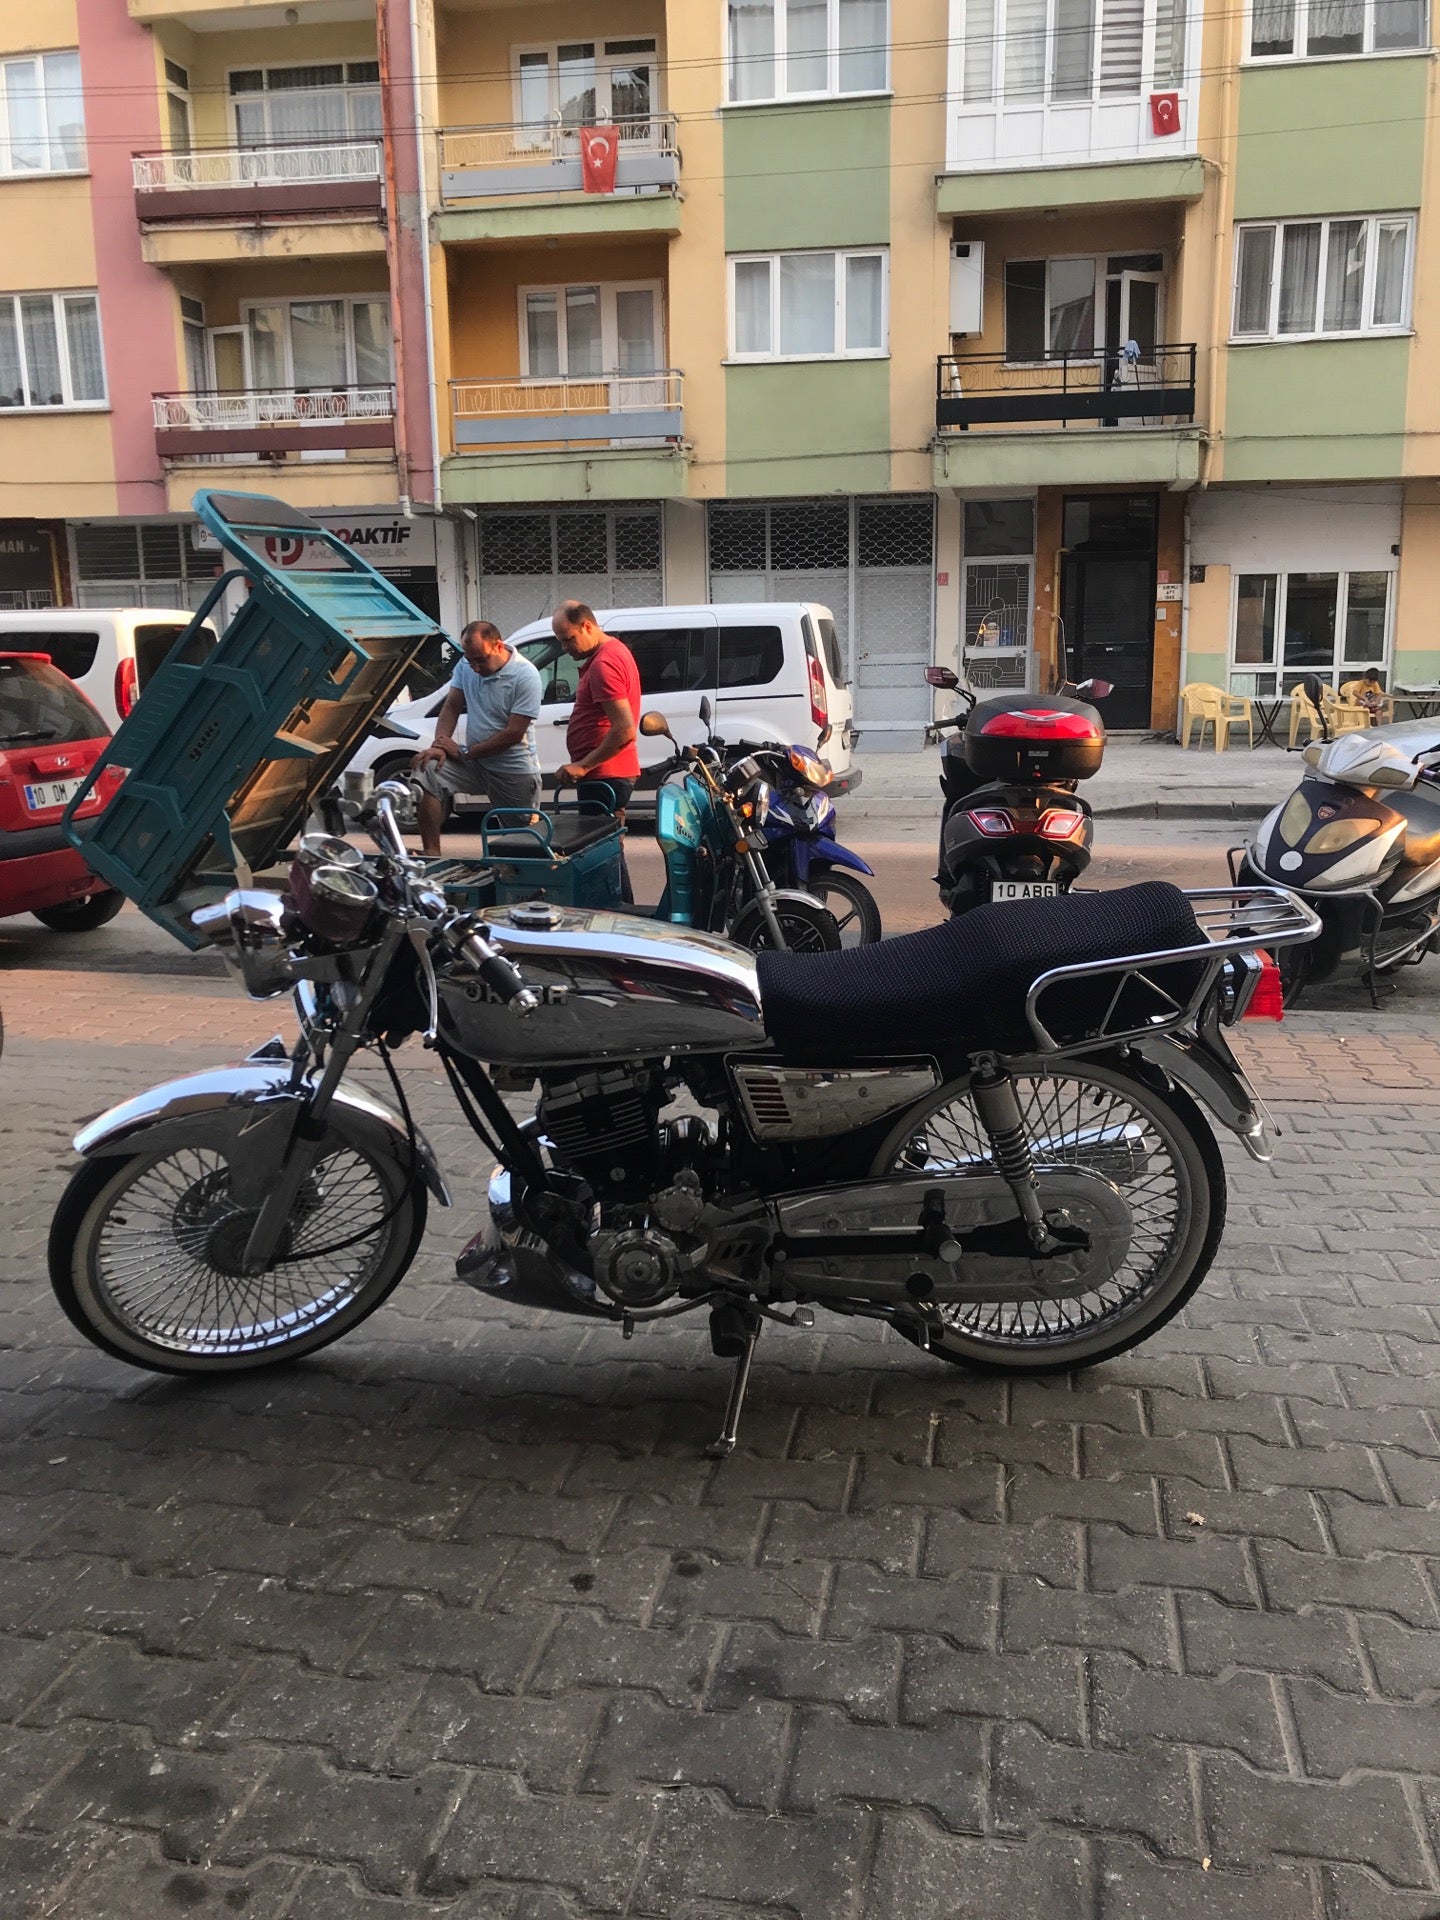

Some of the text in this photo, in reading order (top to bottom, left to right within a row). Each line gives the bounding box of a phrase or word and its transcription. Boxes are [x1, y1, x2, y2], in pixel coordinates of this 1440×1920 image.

[309, 521, 411, 546] OAKTİF
[33, 787, 46, 805] 10
[52, 784, 68, 802] DM
[998, 884, 1054, 898] 10 ABG
